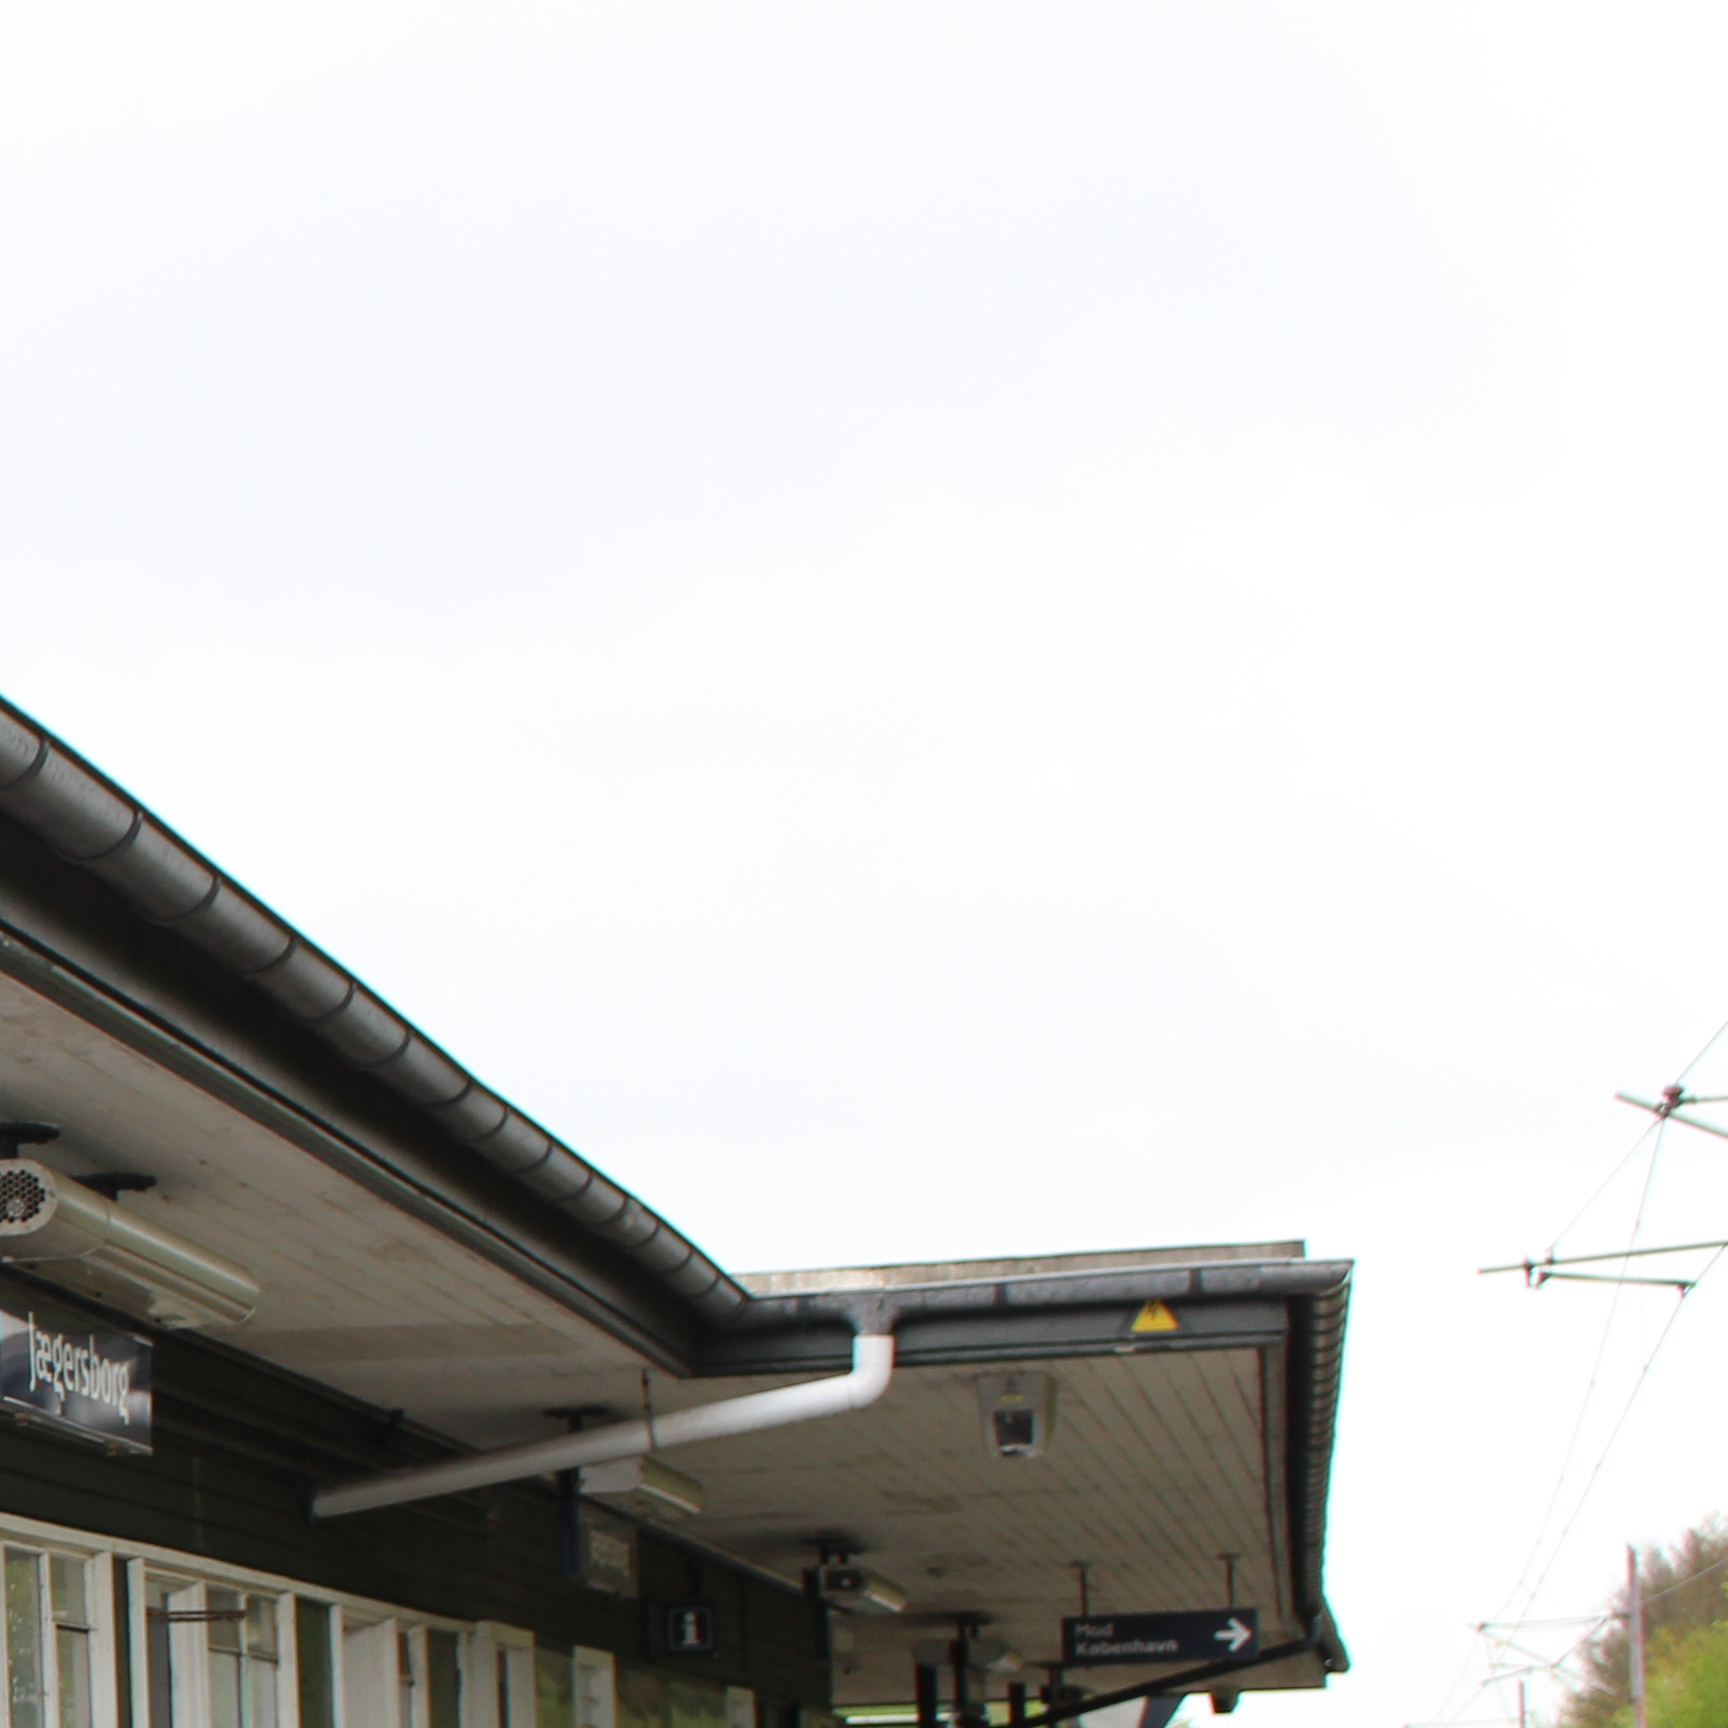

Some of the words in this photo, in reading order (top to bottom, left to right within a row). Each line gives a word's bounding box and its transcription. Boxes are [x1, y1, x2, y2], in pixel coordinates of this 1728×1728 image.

[28, 1311, 130, 1426] Jægersborg
[1075, 1623, 1115, 1637] Mod
[1075, 1638, 1179, 1656] København
